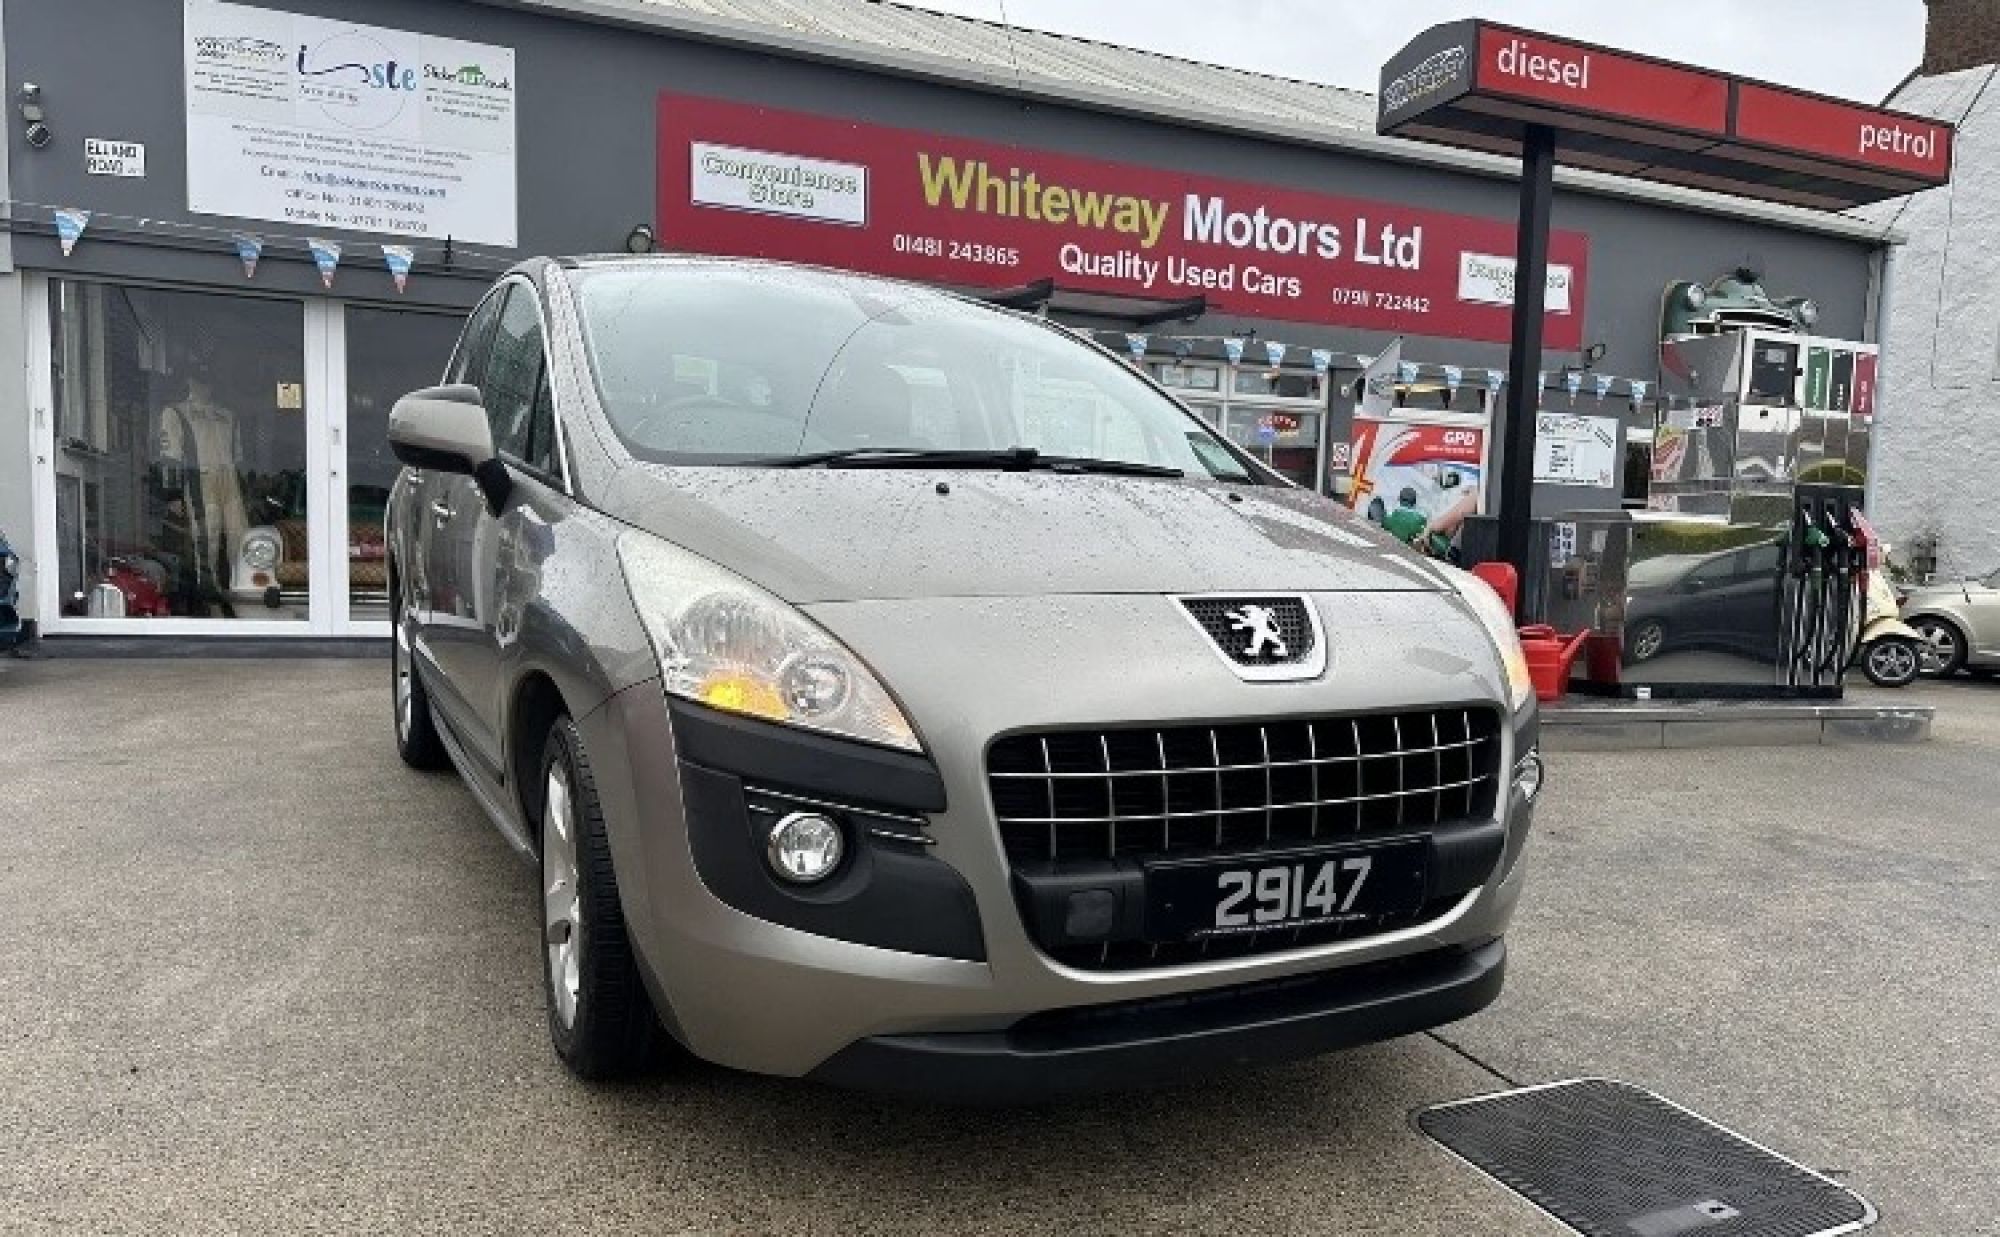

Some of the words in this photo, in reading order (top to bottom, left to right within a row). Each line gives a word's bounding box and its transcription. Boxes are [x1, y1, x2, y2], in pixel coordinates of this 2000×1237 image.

[1497, 41, 1588, 90] diesel
[88, 141, 136, 158] ELLAND
[1860, 122, 1935, 160] petrol
[88, 157, 123, 173] ROAD
[702, 151, 857, 194] Convenience
[749, 181, 814, 209] Store
[917, 151, 1170, 248] Whiteway
[1183, 194, 1340, 260] Motors
[1354, 218, 1422, 270] Ltd
[893, 233, 943, 257] 01481
[949, 241, 1019, 266] 243865
[1059, 242, 1160, 289] Quality
[1167, 257, 1234, 292] Used
[1241, 266, 1302, 298] Cars
[1375, 292, 1430, 313] 722442
[1215, 856, 1372, 927] 29147
